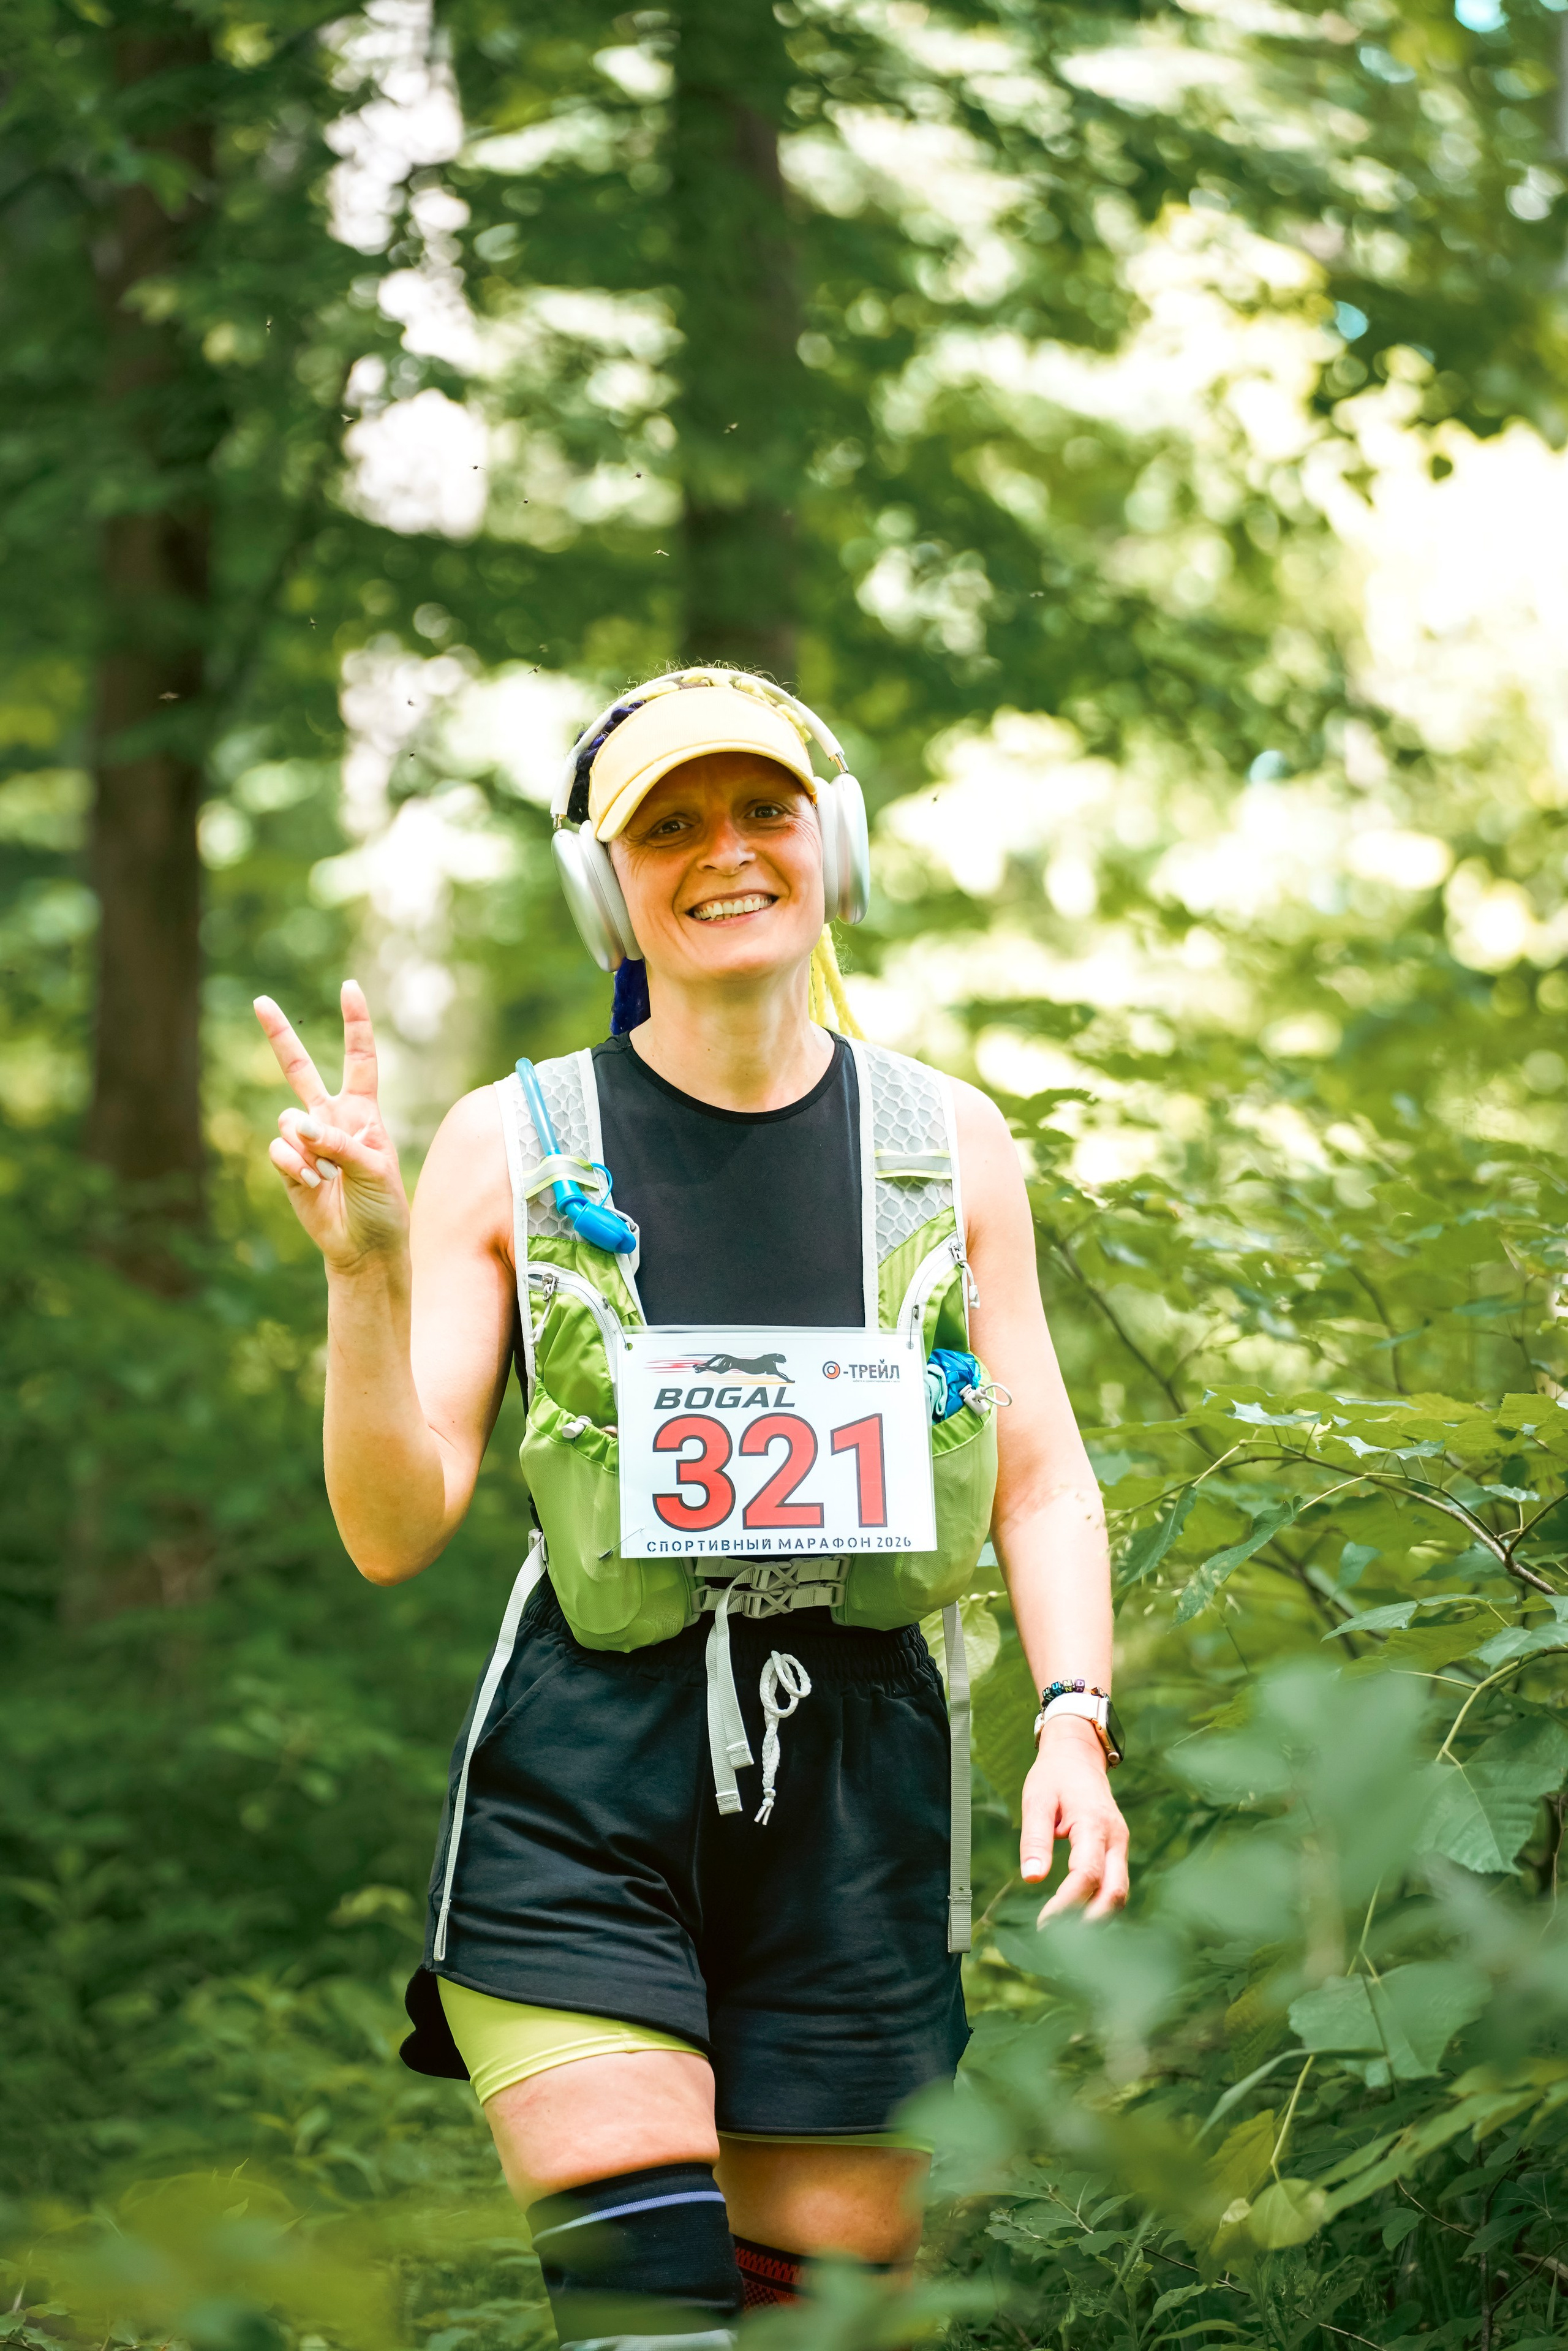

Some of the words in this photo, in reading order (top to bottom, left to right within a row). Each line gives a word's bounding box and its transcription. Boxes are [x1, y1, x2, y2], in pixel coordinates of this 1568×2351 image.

[654, 1387, 795, 1409] BOGAL
[652, 1413, 888, 1532] 321
[647, 1539, 771, 1552] СПОРТИВНЫЙ
[778, 1537, 870, 1550] МАРАФОН
[877, 1536, 911, 1547] 2026
